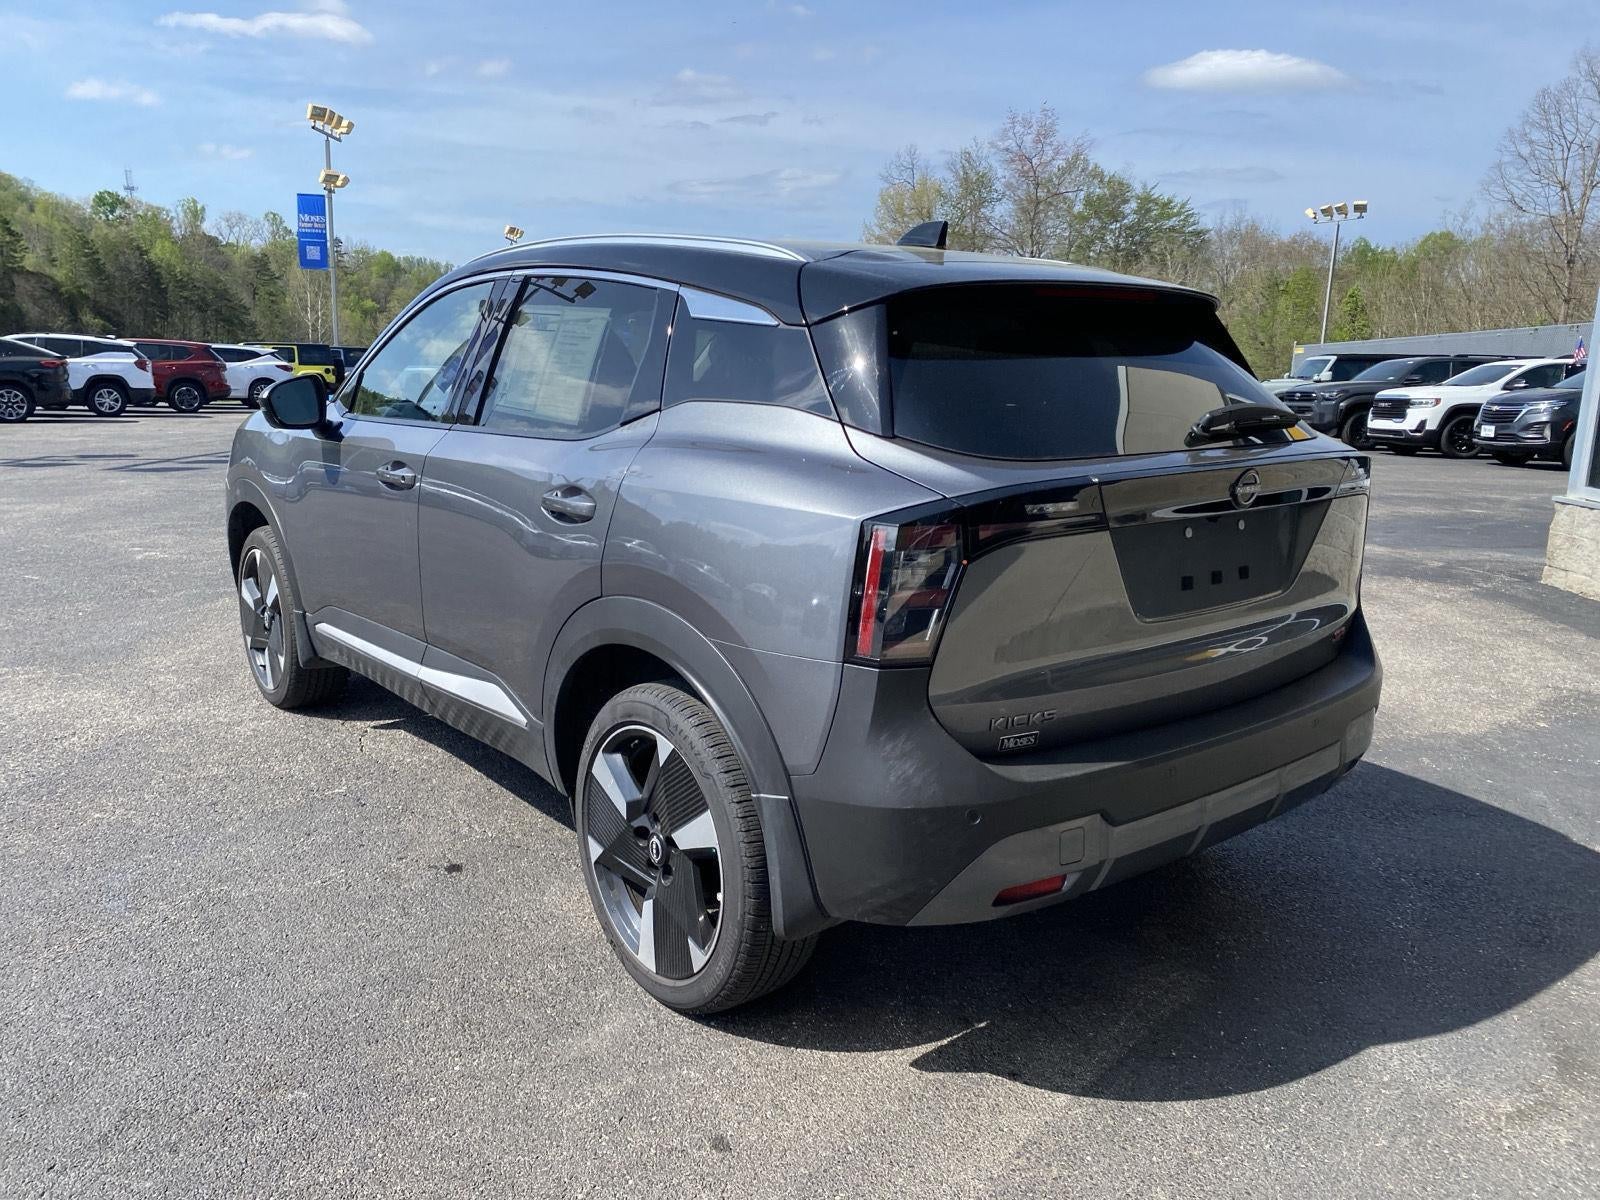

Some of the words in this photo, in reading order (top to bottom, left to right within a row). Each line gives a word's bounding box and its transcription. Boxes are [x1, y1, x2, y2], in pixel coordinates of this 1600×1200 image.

[299, 213, 325, 222] MOSES
[989, 708, 1057, 731] KICKS
[1002, 735, 1035, 749] MOSES
